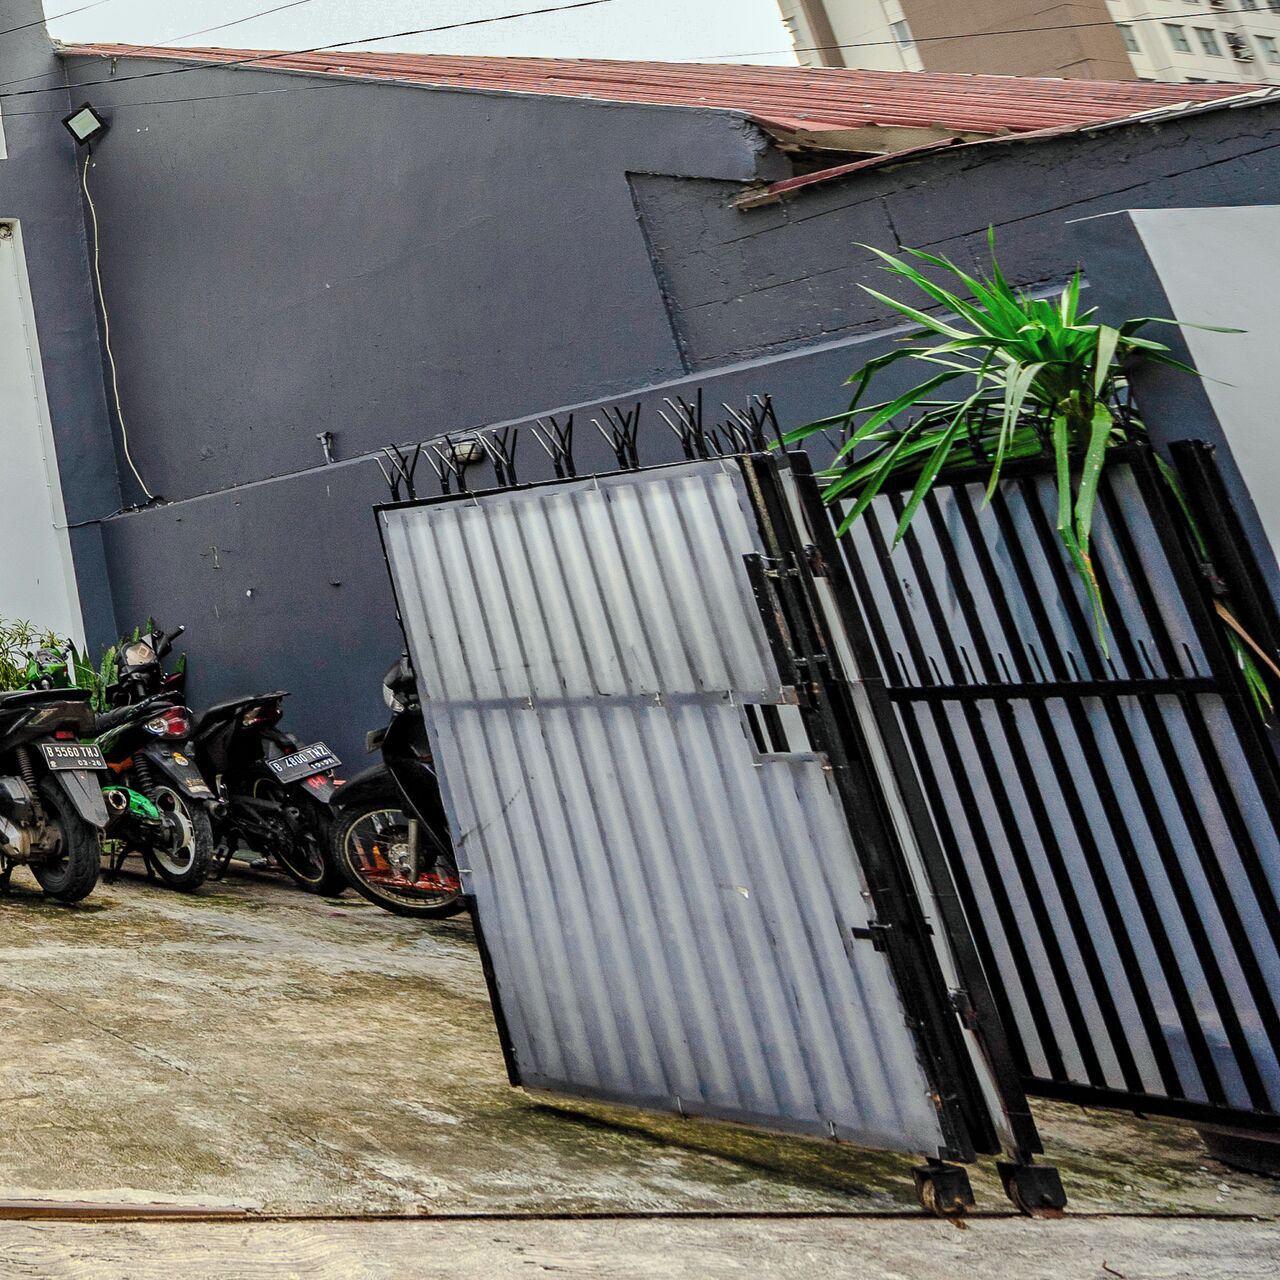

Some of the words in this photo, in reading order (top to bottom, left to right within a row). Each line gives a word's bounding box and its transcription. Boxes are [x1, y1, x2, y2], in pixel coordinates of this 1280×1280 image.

[46, 746, 54, 757] B
[54, 746, 80, 757] 5560
[272, 761, 283, 772] B
